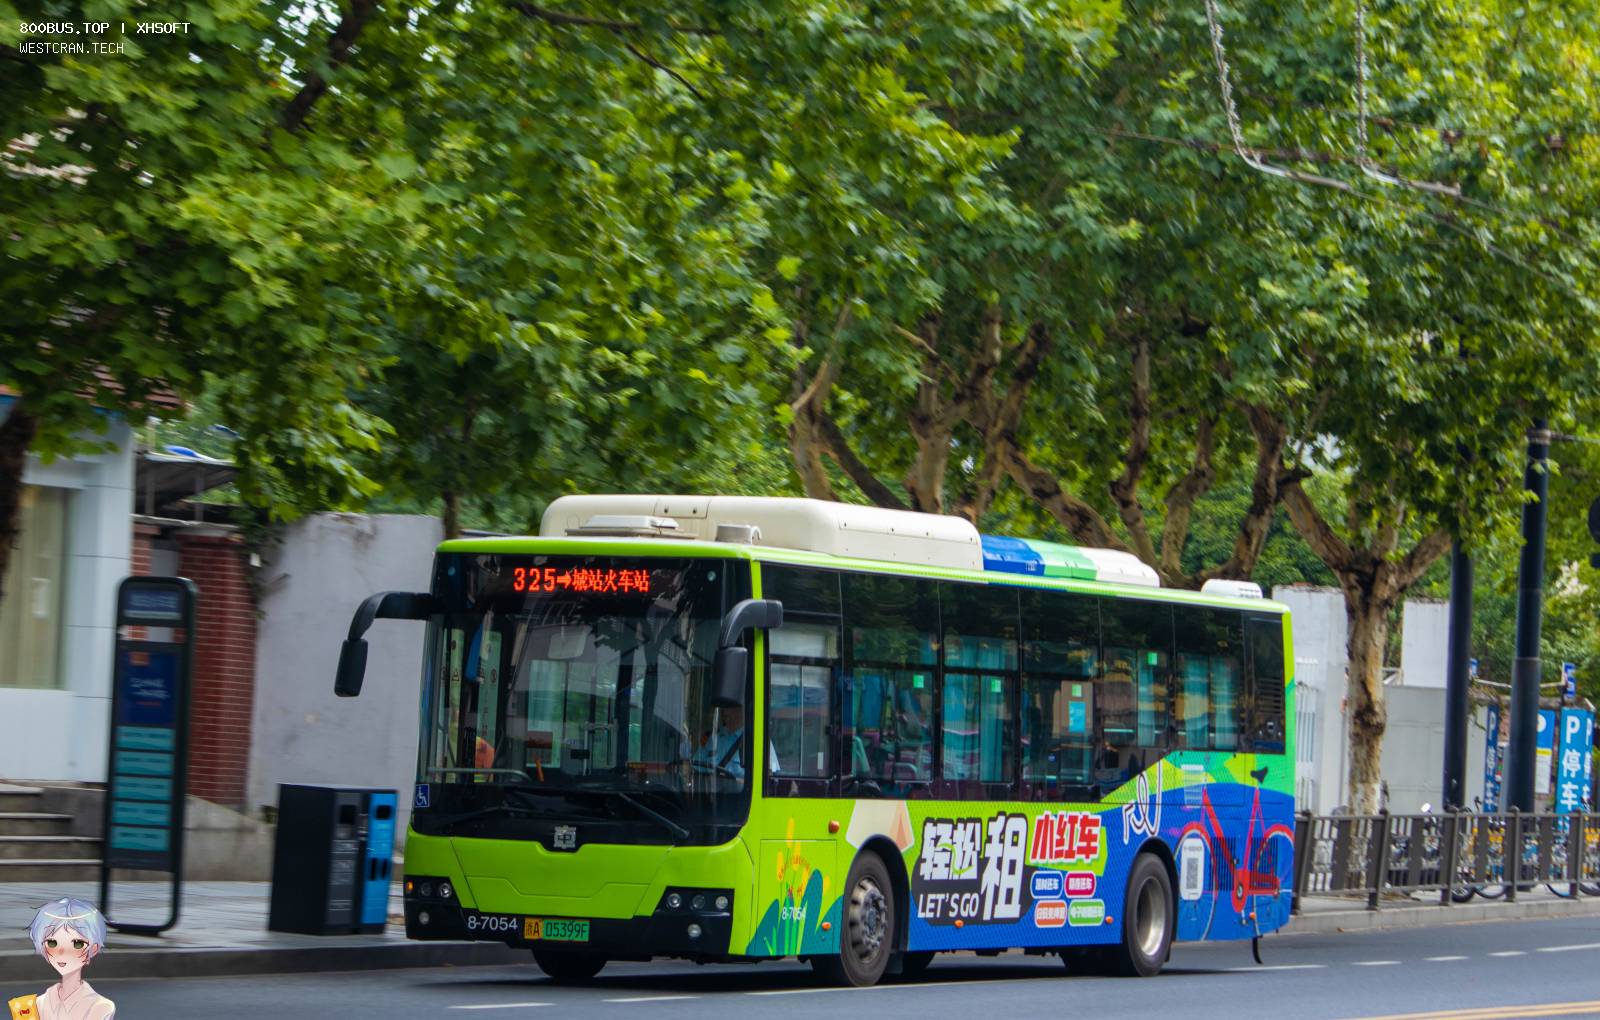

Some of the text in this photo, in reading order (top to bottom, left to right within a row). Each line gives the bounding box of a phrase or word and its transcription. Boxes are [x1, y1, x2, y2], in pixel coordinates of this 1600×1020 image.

[513, 567, 557, 592] 325
[572, 569, 650, 593] 城站火车站
[1030, 813, 1101, 862] 小红车
[466, 915, 519, 931] 8-7054
